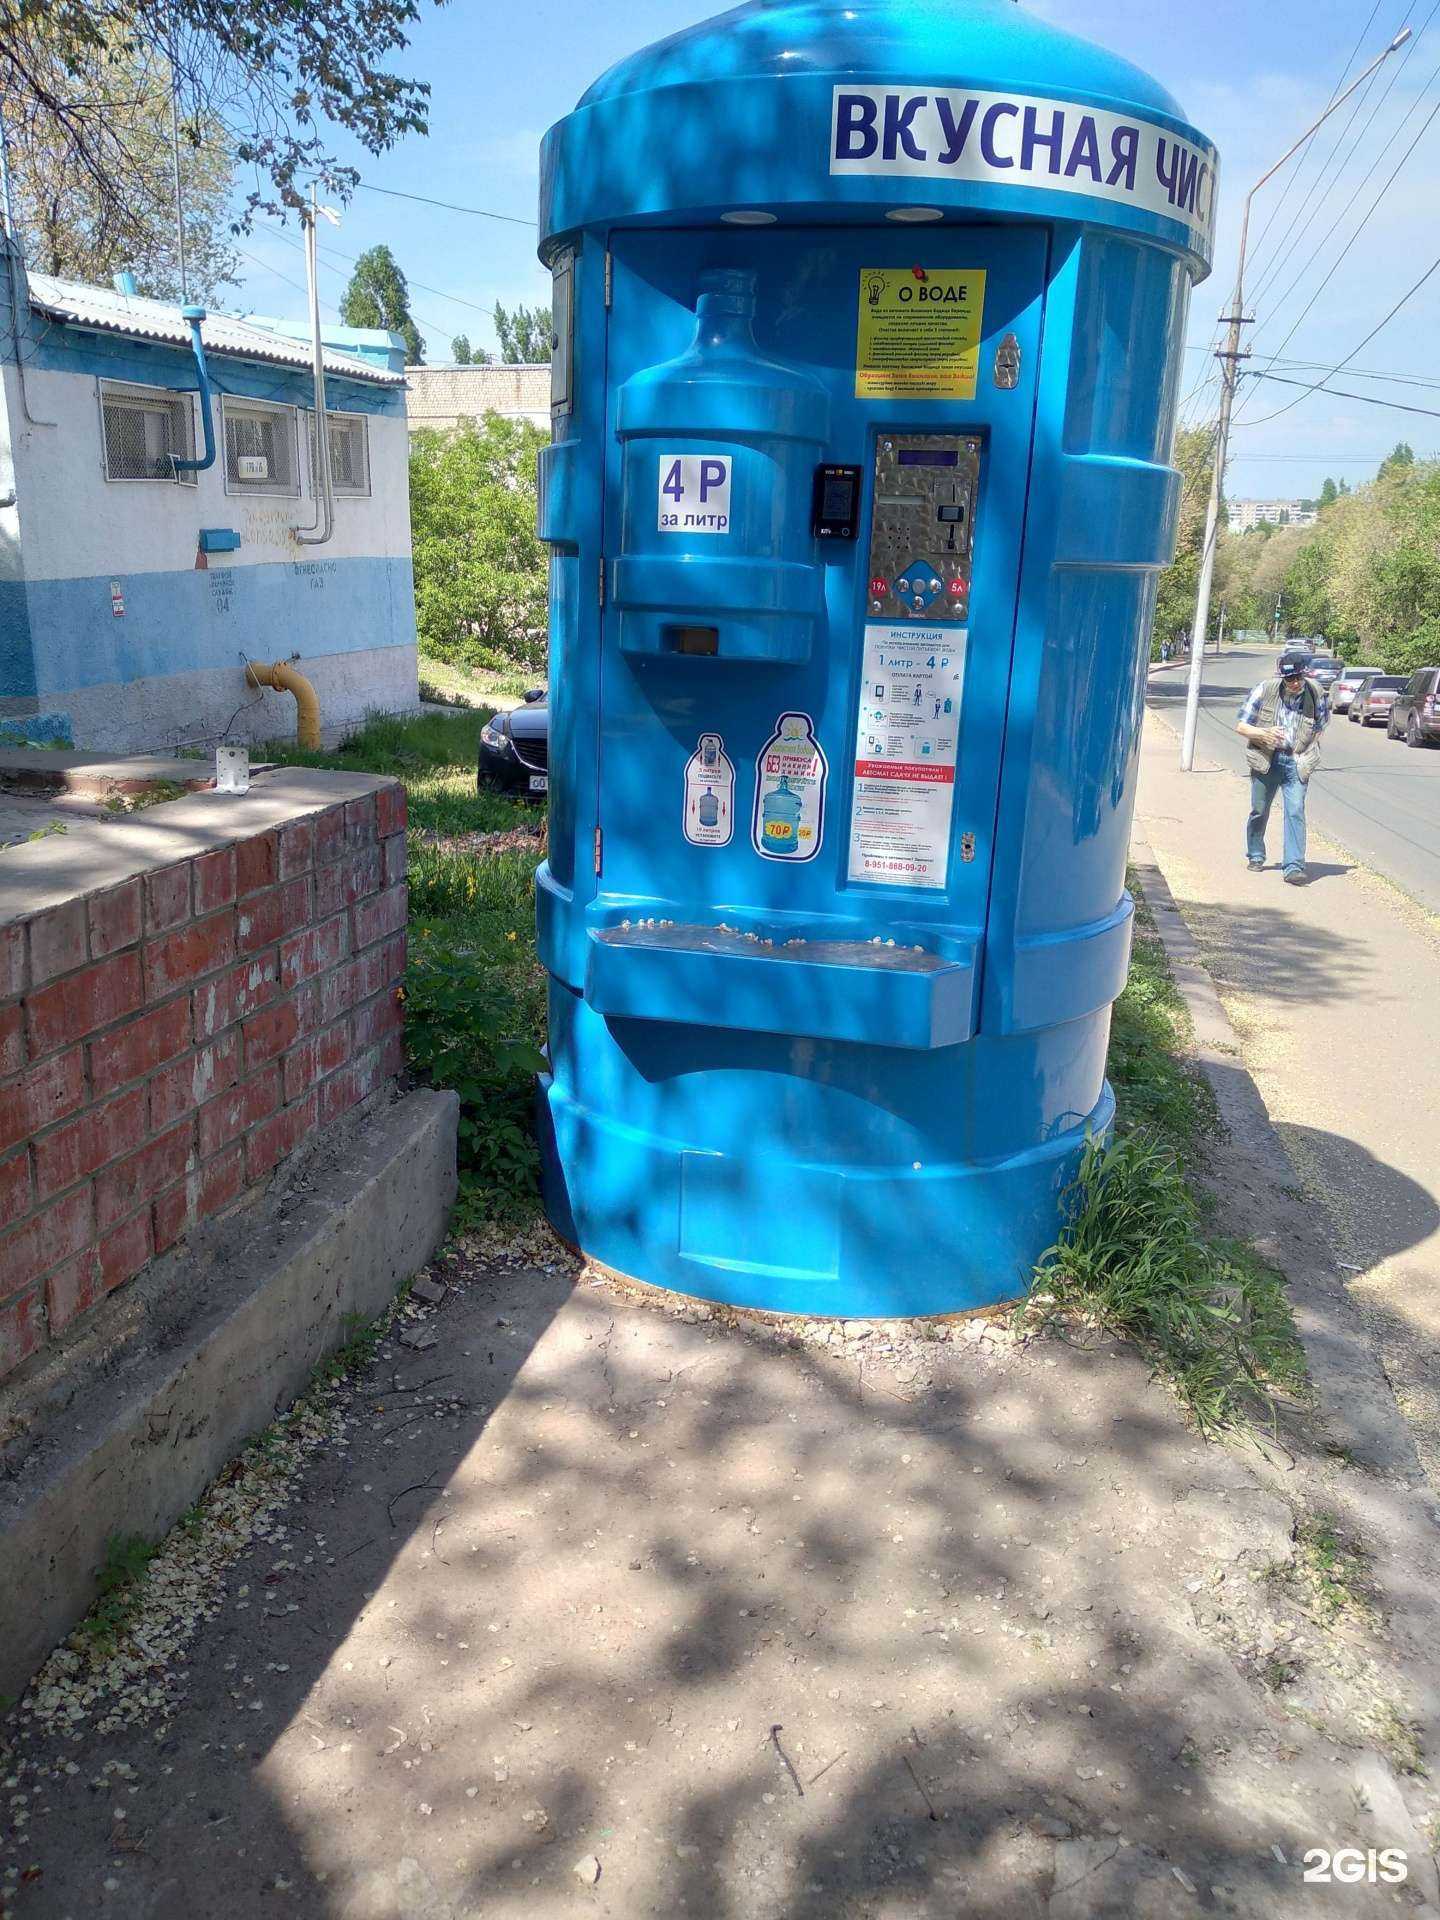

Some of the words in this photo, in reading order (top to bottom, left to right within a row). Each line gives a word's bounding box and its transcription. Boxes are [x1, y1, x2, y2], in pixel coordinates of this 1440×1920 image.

[835, 94, 1140, 190] ВКУСНАЯ
[898, 286, 913, 302] О
[919, 285, 968, 303] ВОДЕ
[662, 459, 685, 503] 4
[660, 513, 679, 526] за
[683, 513, 728, 531] литр
[890, 631, 944, 641] ИНСТРУКЦИЯ
[879, 654, 884, 665] 1
[888, 659, 913, 669] литр
[926, 655, 936, 669] 4
[766, 754, 781, 774] БЕЗ
[855, 806, 862, 816] 2
[853, 832, 860, 842] 3
